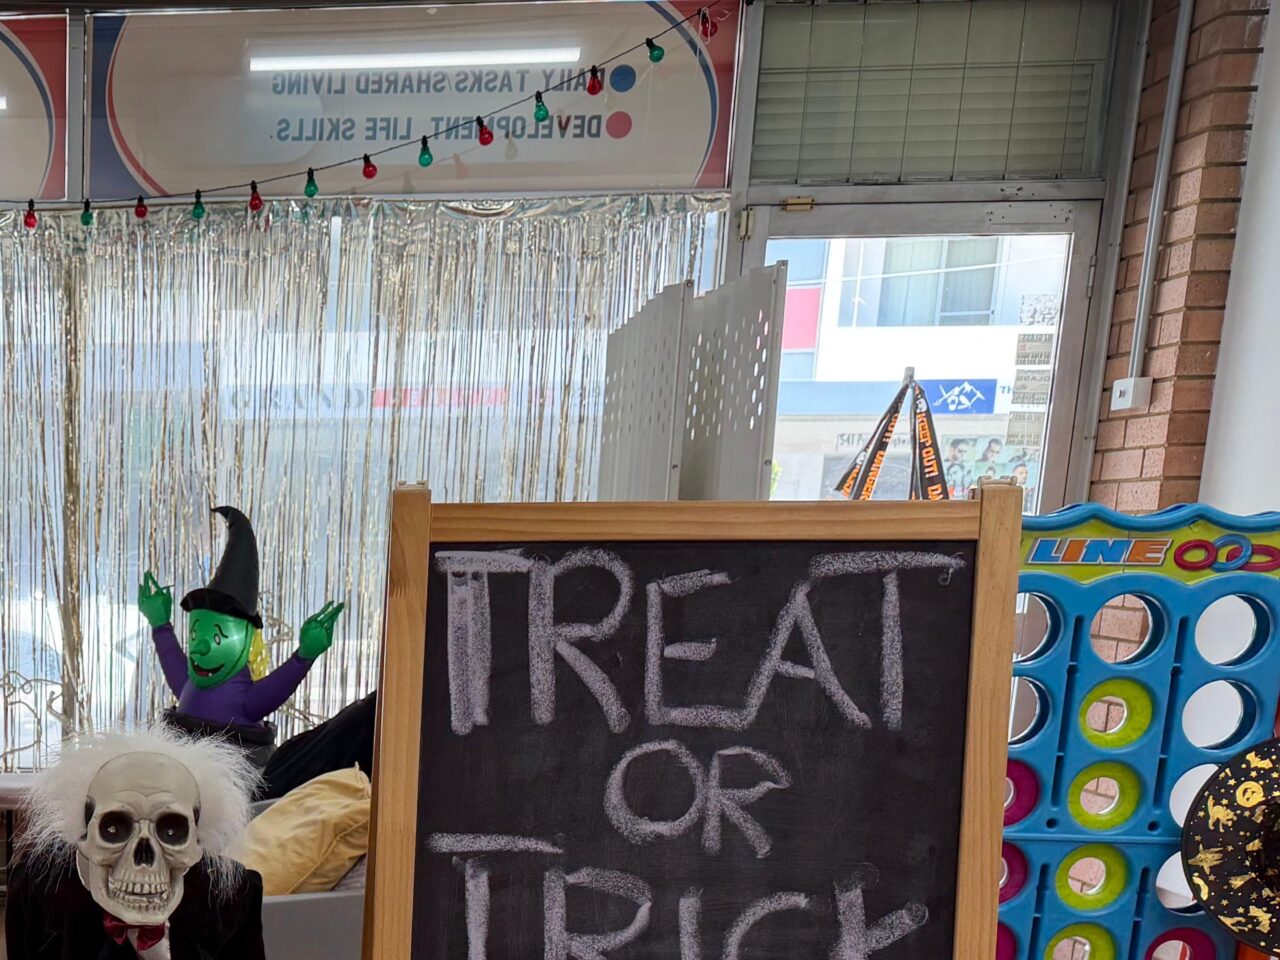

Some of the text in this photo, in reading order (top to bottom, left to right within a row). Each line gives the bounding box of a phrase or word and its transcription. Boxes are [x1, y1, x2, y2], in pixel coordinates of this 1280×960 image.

[921, 446, 939, 479] OUT!
[1025, 537, 1173, 566] LINE
[434, 547, 966, 736] TREAT
[604, 739, 794, 859] OR
